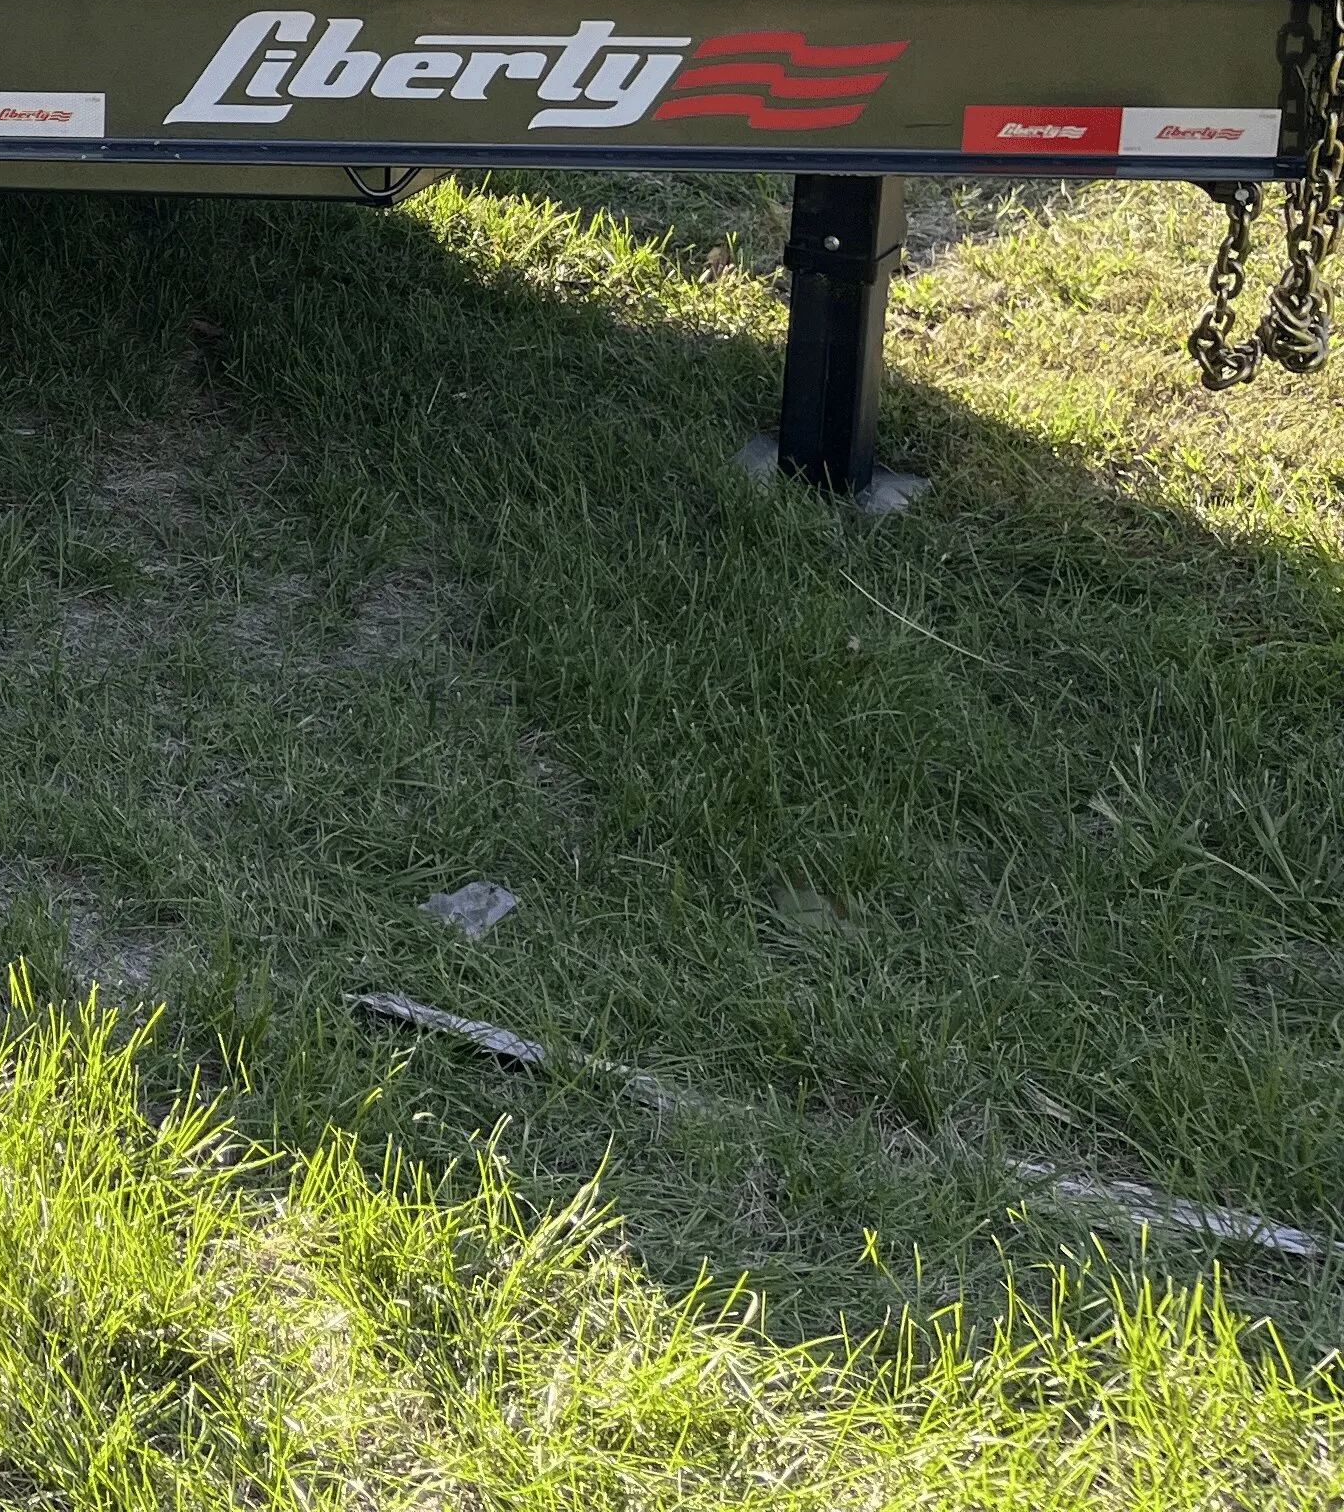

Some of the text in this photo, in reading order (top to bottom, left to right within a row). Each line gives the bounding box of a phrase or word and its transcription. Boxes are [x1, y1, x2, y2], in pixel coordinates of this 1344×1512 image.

[163, 10, 692, 129] Liberty
[996, 122, 1062, 139] Liberty
[1155, 125, 1217, 140] Liberty
